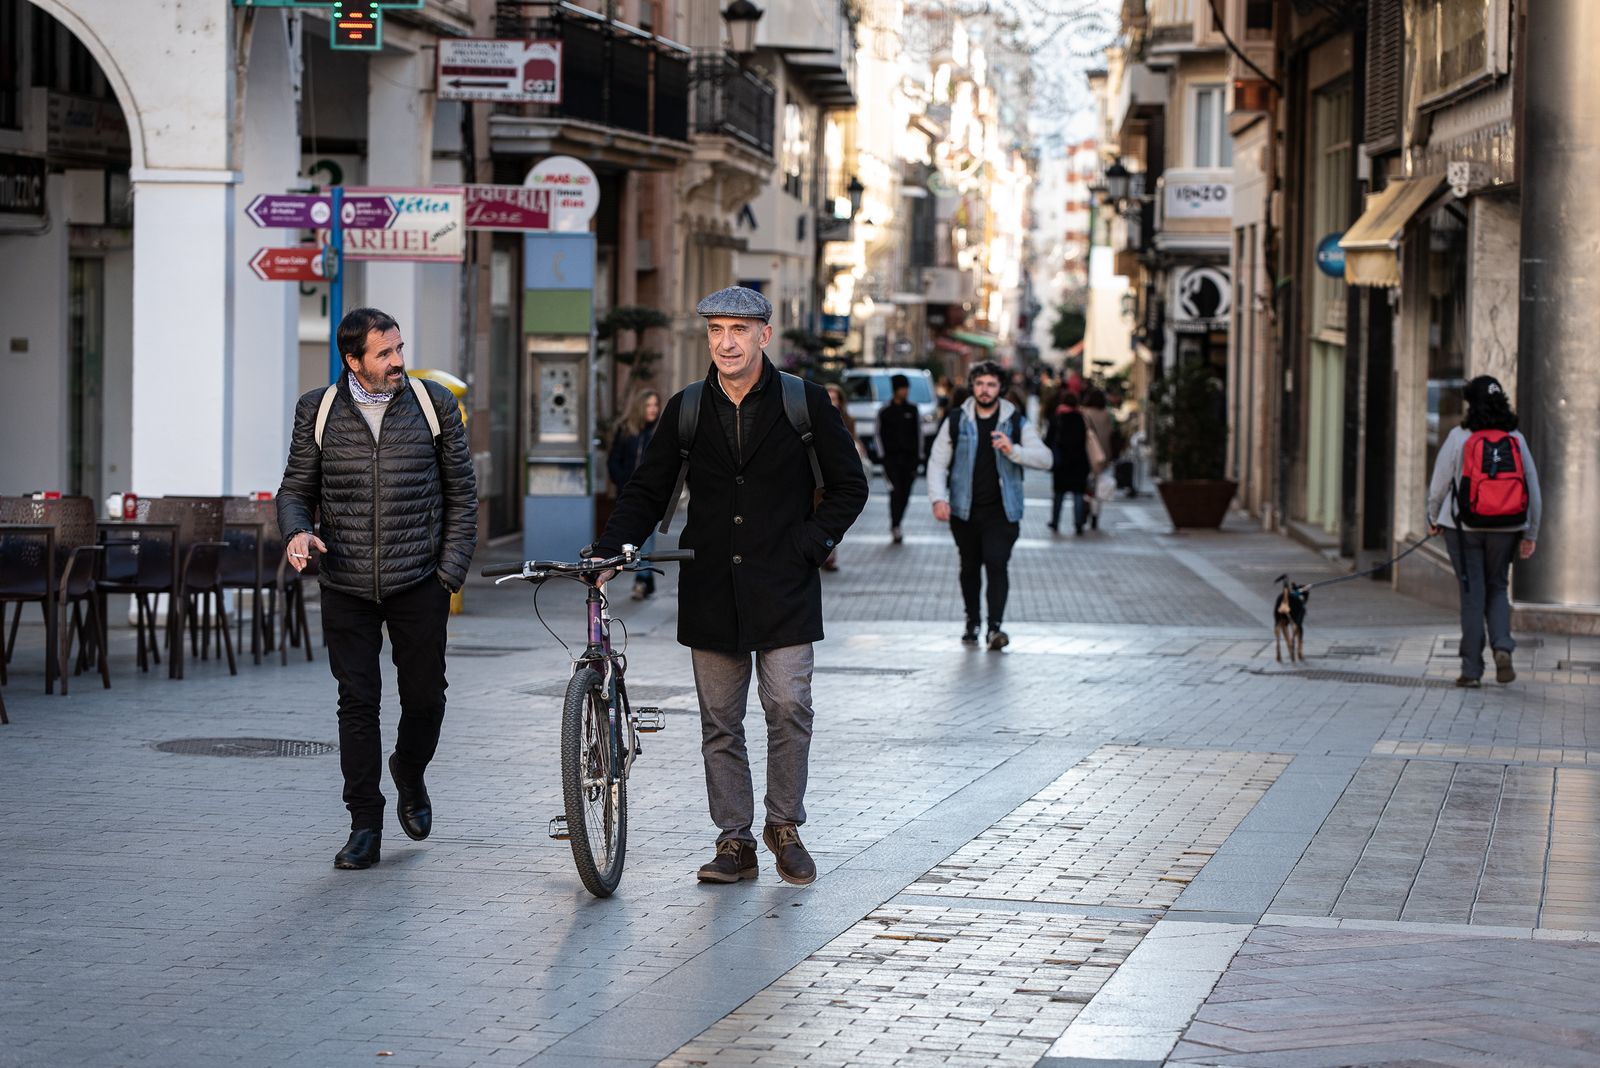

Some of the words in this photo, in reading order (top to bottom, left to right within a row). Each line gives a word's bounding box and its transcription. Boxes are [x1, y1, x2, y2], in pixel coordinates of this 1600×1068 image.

[525, 79, 555, 93] CGT
[394, 195, 449, 213] tética
[466, 186, 549, 214] UQUERIA
